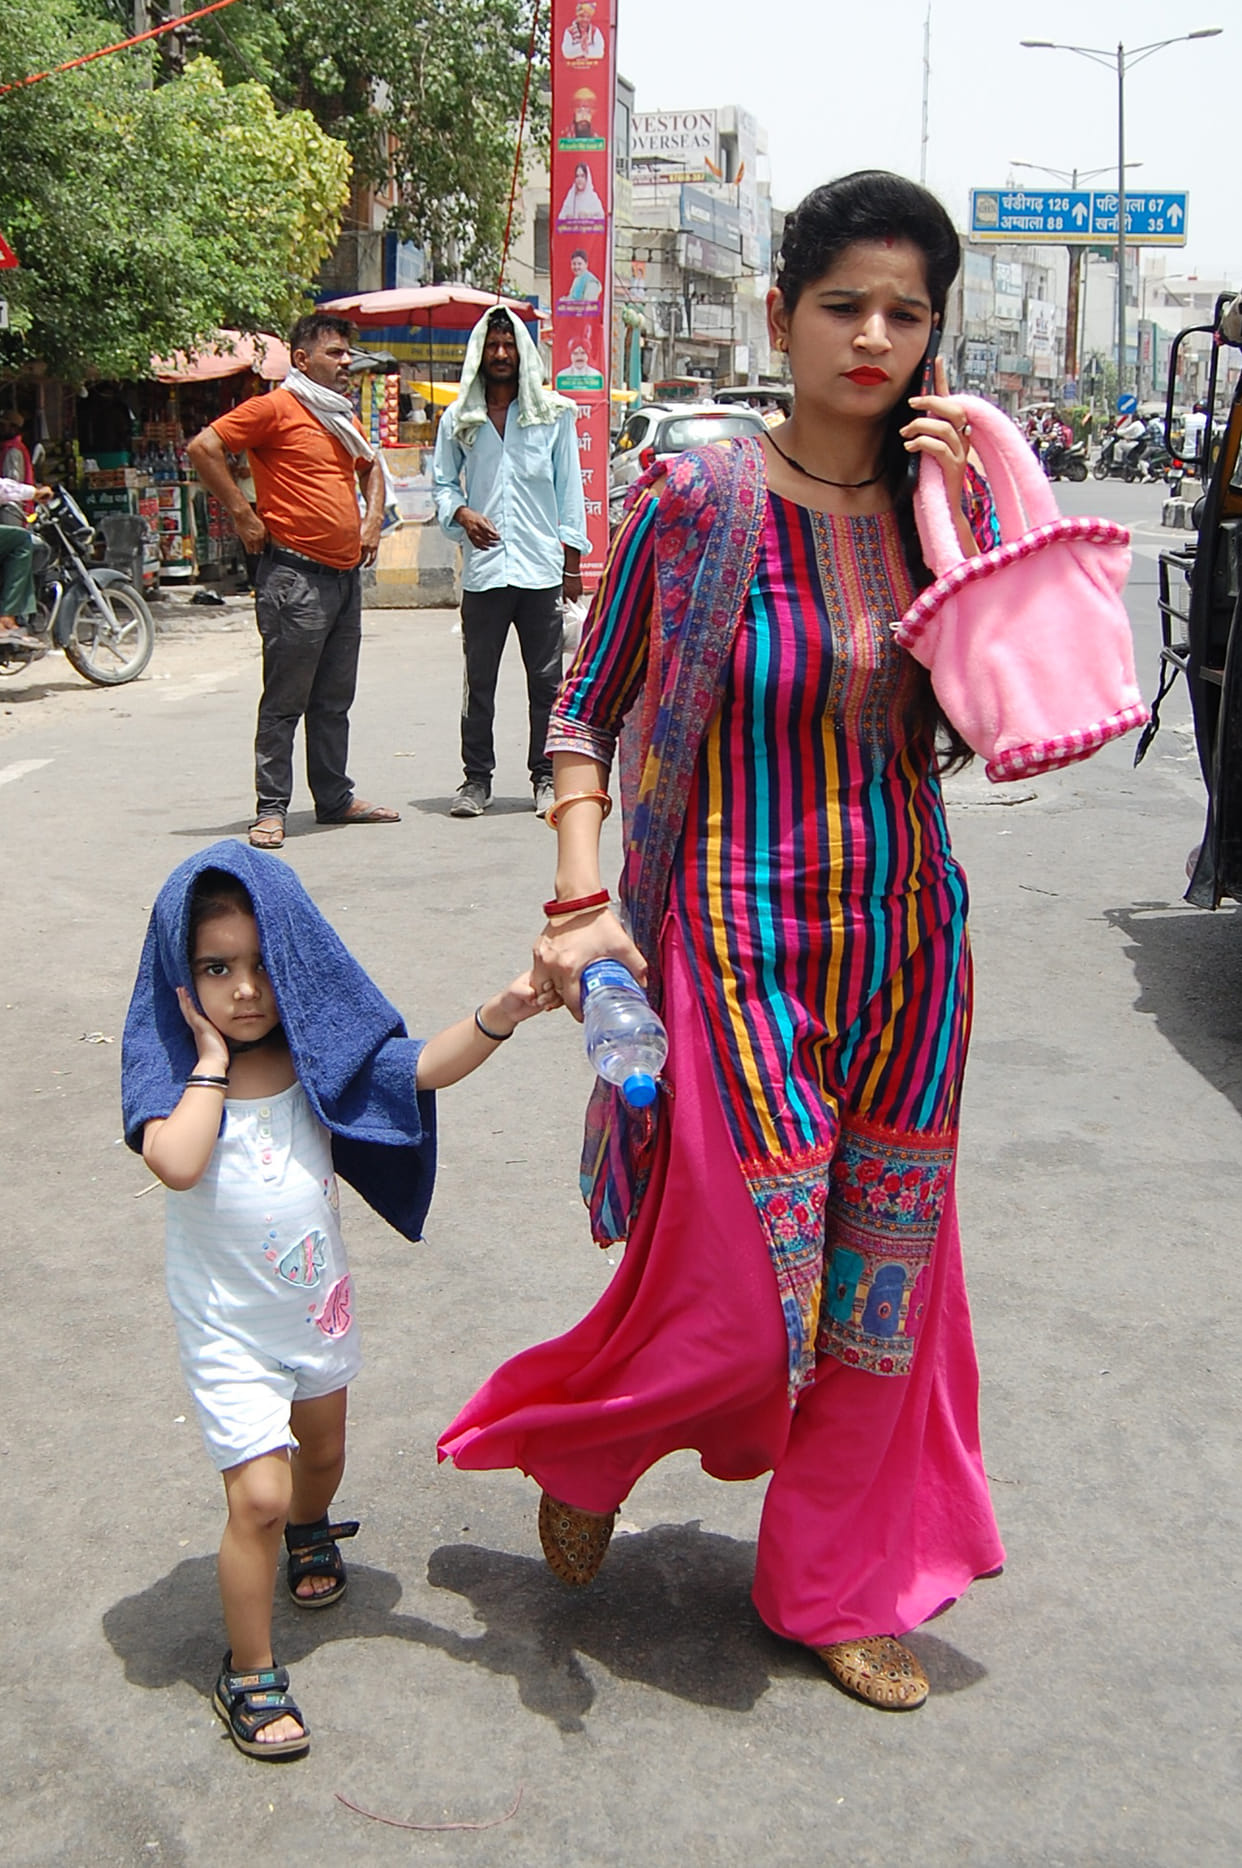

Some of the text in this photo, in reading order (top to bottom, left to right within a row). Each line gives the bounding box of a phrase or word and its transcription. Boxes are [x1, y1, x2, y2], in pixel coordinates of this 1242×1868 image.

[1048, 198, 1069, 211] 126
[1148, 199, 1164, 212] 67
[1047, 217, 1063, 230] 88
[1147, 218, 1164, 231] 35
